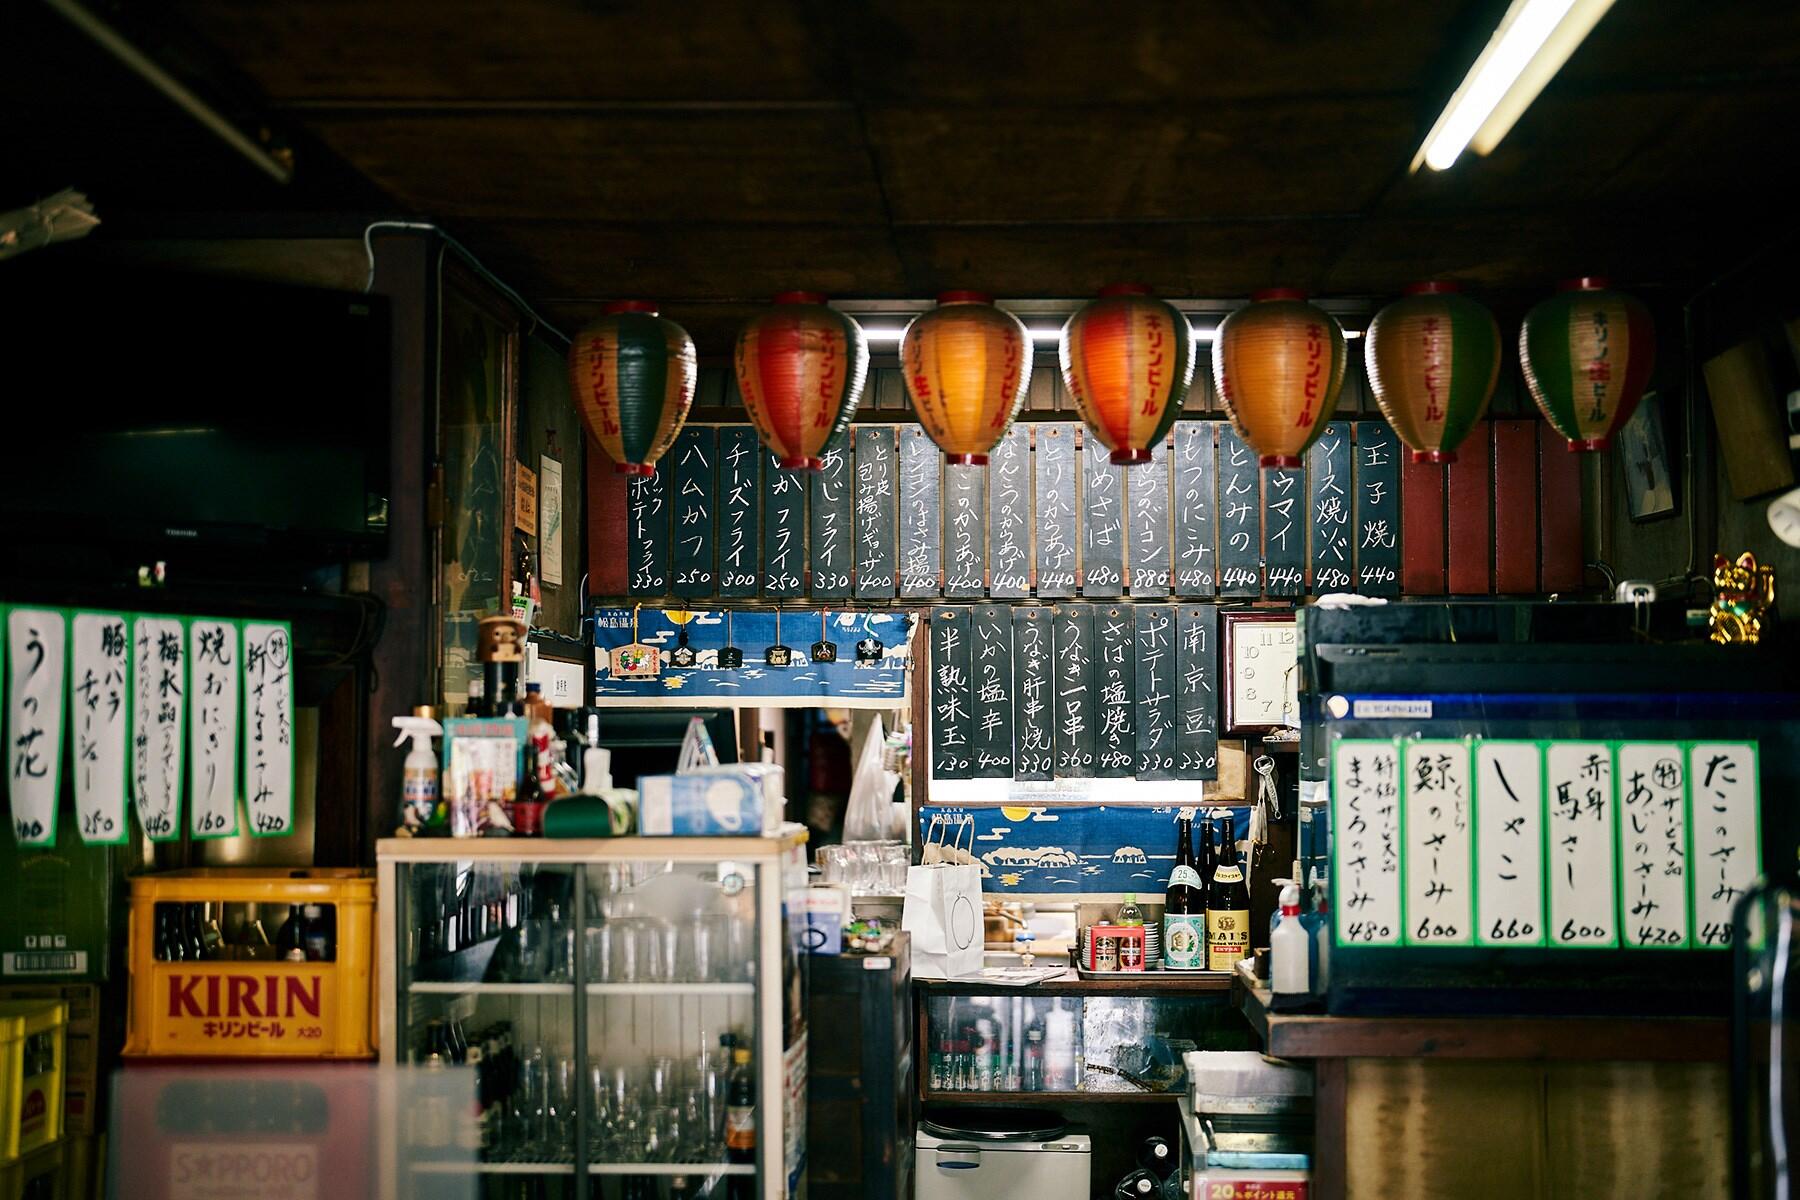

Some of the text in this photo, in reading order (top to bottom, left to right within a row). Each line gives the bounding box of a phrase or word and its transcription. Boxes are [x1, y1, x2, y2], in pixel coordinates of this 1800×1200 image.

[1141, 314, 1164, 416] キリンビール
[1296, 323, 1322, 428] キリンビール
[590, 336, 620, 436] キリンビール
[813, 328, 837, 429] キリンビール
[875, 445, 891, 497] とり皮
[680, 444, 708, 557] ハムかつ
[1089, 438, 1121, 548] しめさば
[1182, 435, 1210, 566] もつのにこみ
[1316, 439, 1348, 561] ソース焼ソバ
[1361, 442, 1396, 549] 玉子焼
[726, 443, 752, 567] チーズフライ
[820, 449, 843, 567] あじフライ
[996, 440, 1025, 572] なんこつのからあげ
[1043, 440, 1073, 569] とりのからあげ
[1268, 472, 1295, 551] ウマイ
[856, 463, 885, 572] 包み揚げギョーザ
[953, 470, 981, 577] このからあげ
[632, 574, 663, 589] 330
[677, 567, 711, 584] 250
[722, 570, 755, 587] 300
[766, 572, 800, 591] 250
[815, 572, 849, 589] 330
[859, 574, 891, 589] 400
[904, 574, 935, 592] 400
[948, 575, 982, 592] 400
[993, 573, 1026, 590] 400
[1041, 572, 1075, 588] 440
[1087, 568, 1120, 585] 480
[1134, 568, 1168, 588] 880
[1179, 570, 1211, 588] 480
[1223, 568, 1257, 587] 440
[1268, 567, 1302, 586] 440
[1316, 568, 1350, 588] 480
[1360, 566, 1396, 585] 440
[1260, 633, 1272, 646] 11
[1279, 632, 1294, 645] 12
[1244, 646, 1259, 659] 10
[101, 623, 128, 722] 豚バラ
[977, 623, 1007, 741] いかの塩辛
[1059, 620, 1089, 745] うなぎ一口串
[1183, 623, 1211, 735] 南京豆
[1244, 667, 1255, 679] 9
[936, 628, 970, 747] 半熟味玉
[1101, 620, 1135, 750] さばの塩焼き
[1139, 617, 1173, 751] ポテトサラダ
[1247, 688, 1257, 700] 8
[14, 629, 49, 779] うの花
[197, 623, 232, 801] 焼おにぎり
[1262, 700, 1272, 713] 7
[1282, 702, 1293, 713] 6
[936, 757, 969, 772] 130
[978, 751, 1010, 769] 400
[1019, 754, 1051, 772] 330
[1060, 750, 1092, 767] 360
[1101, 750, 1132, 768] 480
[1139, 754, 1173, 771] 330
[1179, 753, 1215, 770] 330
[1580, 753, 1610, 821] 赤身
[197, 811, 226, 832] 160
[257, 810, 284, 833] 420
[1413, 753, 1455, 905] 鯨のさしみ
[1704, 754, 1745, 903] たこのさしみ
[1552, 780, 1582, 890] 馬さし
[1626, 770, 1659, 919] あじのさしみ
[1178, 870, 1188, 879] 25
[1349, 921, 1390, 941] 480
[1417, 917, 1457, 939] 600
[1491, 918, 1534, 939] 660
[1561, 918, 1606, 941] 600
[1638, 924, 1681, 946] 420
[1701, 922, 1734, 945] 48
[168, 975, 321, 1018] KIRIN
[203, 1021, 285, 1039] キリンビール
